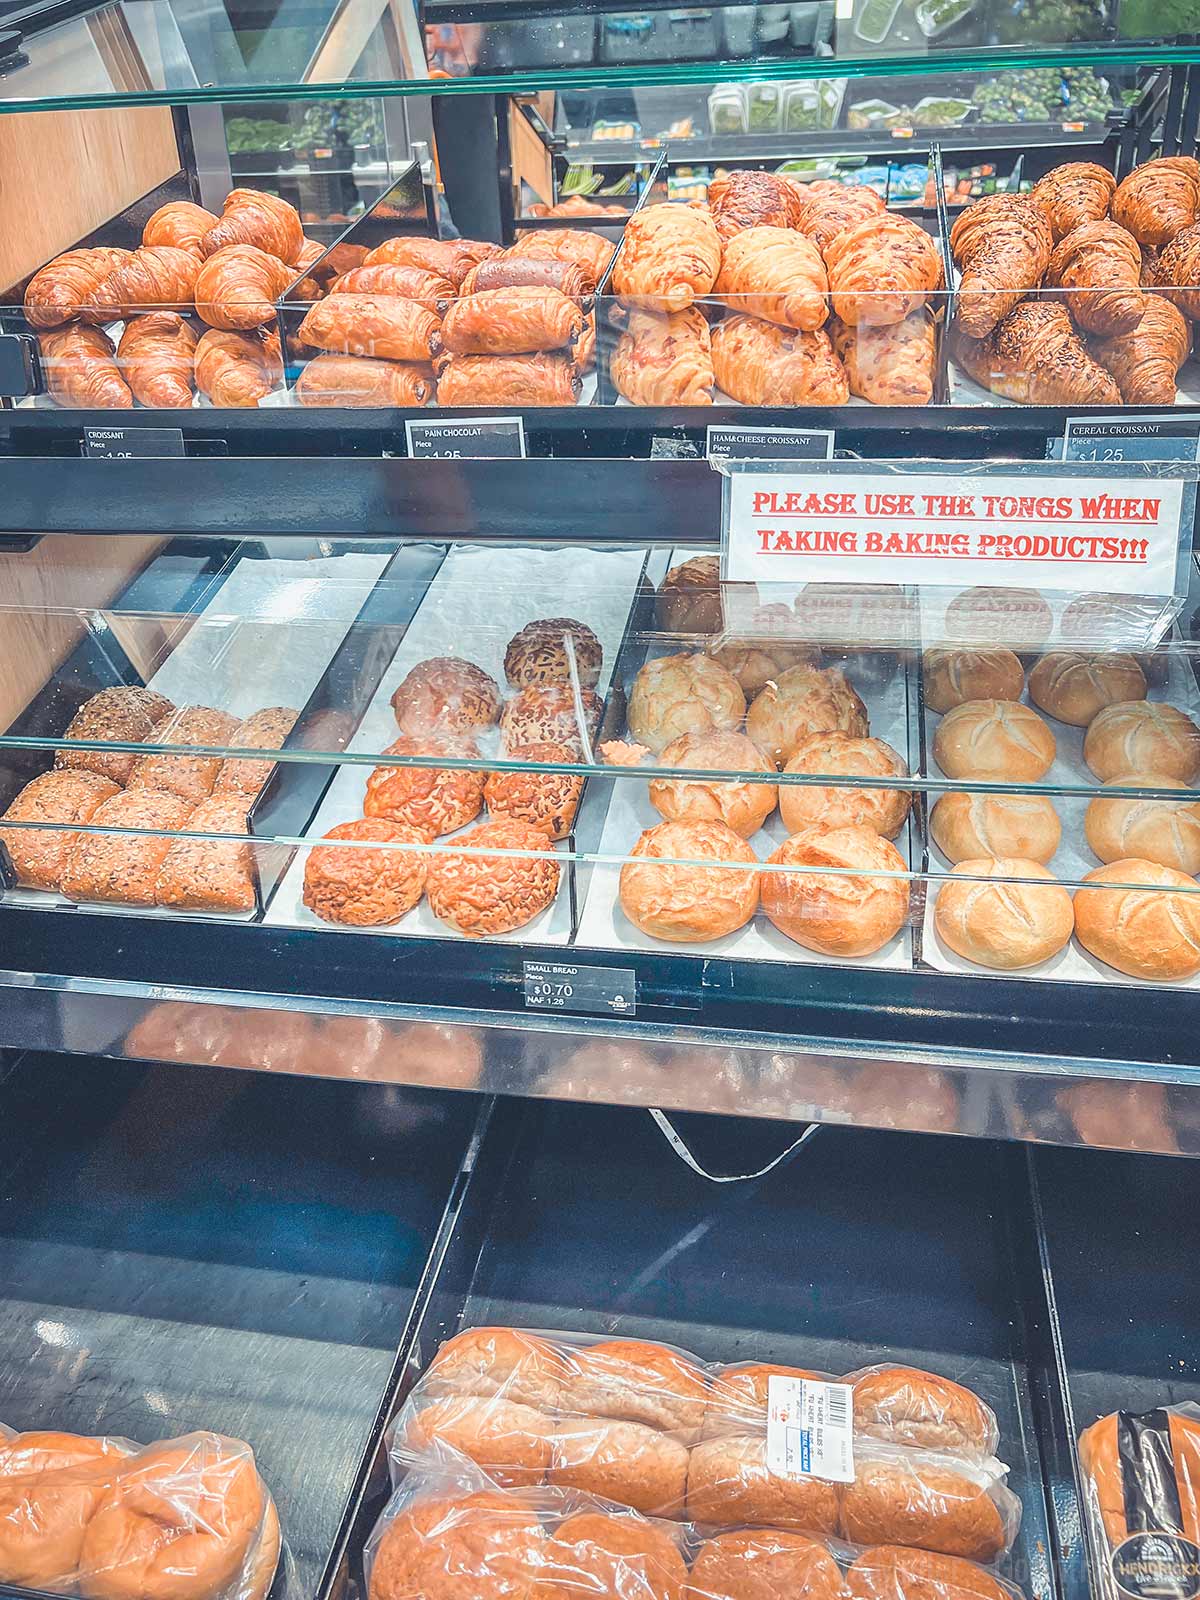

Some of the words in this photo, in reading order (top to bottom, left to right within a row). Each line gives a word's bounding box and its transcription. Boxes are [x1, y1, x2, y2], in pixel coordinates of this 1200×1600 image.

[425, 429, 442, 437] PAIN
[443, 428, 482, 437] CHOCOLAT
[1072, 426, 1108, 435] CEREAL
[1109, 425, 1161, 434] CROISSANT
[88, 431, 124, 439] CROISSANT
[713, 434, 766, 443] HAM&CHEESE
[767, 436, 811, 445] CROISSANT
[1071, 437, 1092, 445] Piece
[415, 440, 432, 448] Piece
[712, 444, 731, 452] Piece
[753, 492, 858, 514] PLEASE
[864, 494, 916, 516] USE
[922, 495, 976, 517] THE
[981, 496, 1073, 519] TONGS
[1079, 493, 1162, 521] WHEN
[757, 530, 858, 552] TAKING
[864, 532, 970, 556] BAKING
[977, 534, 1150, 560] PRODUCTS!!!
[526, 964, 552, 973] SMALL
[552, 967, 578, 975] BREAD
[525, 973, 543, 981] Piece
[527, 996, 545, 1004] NAF
